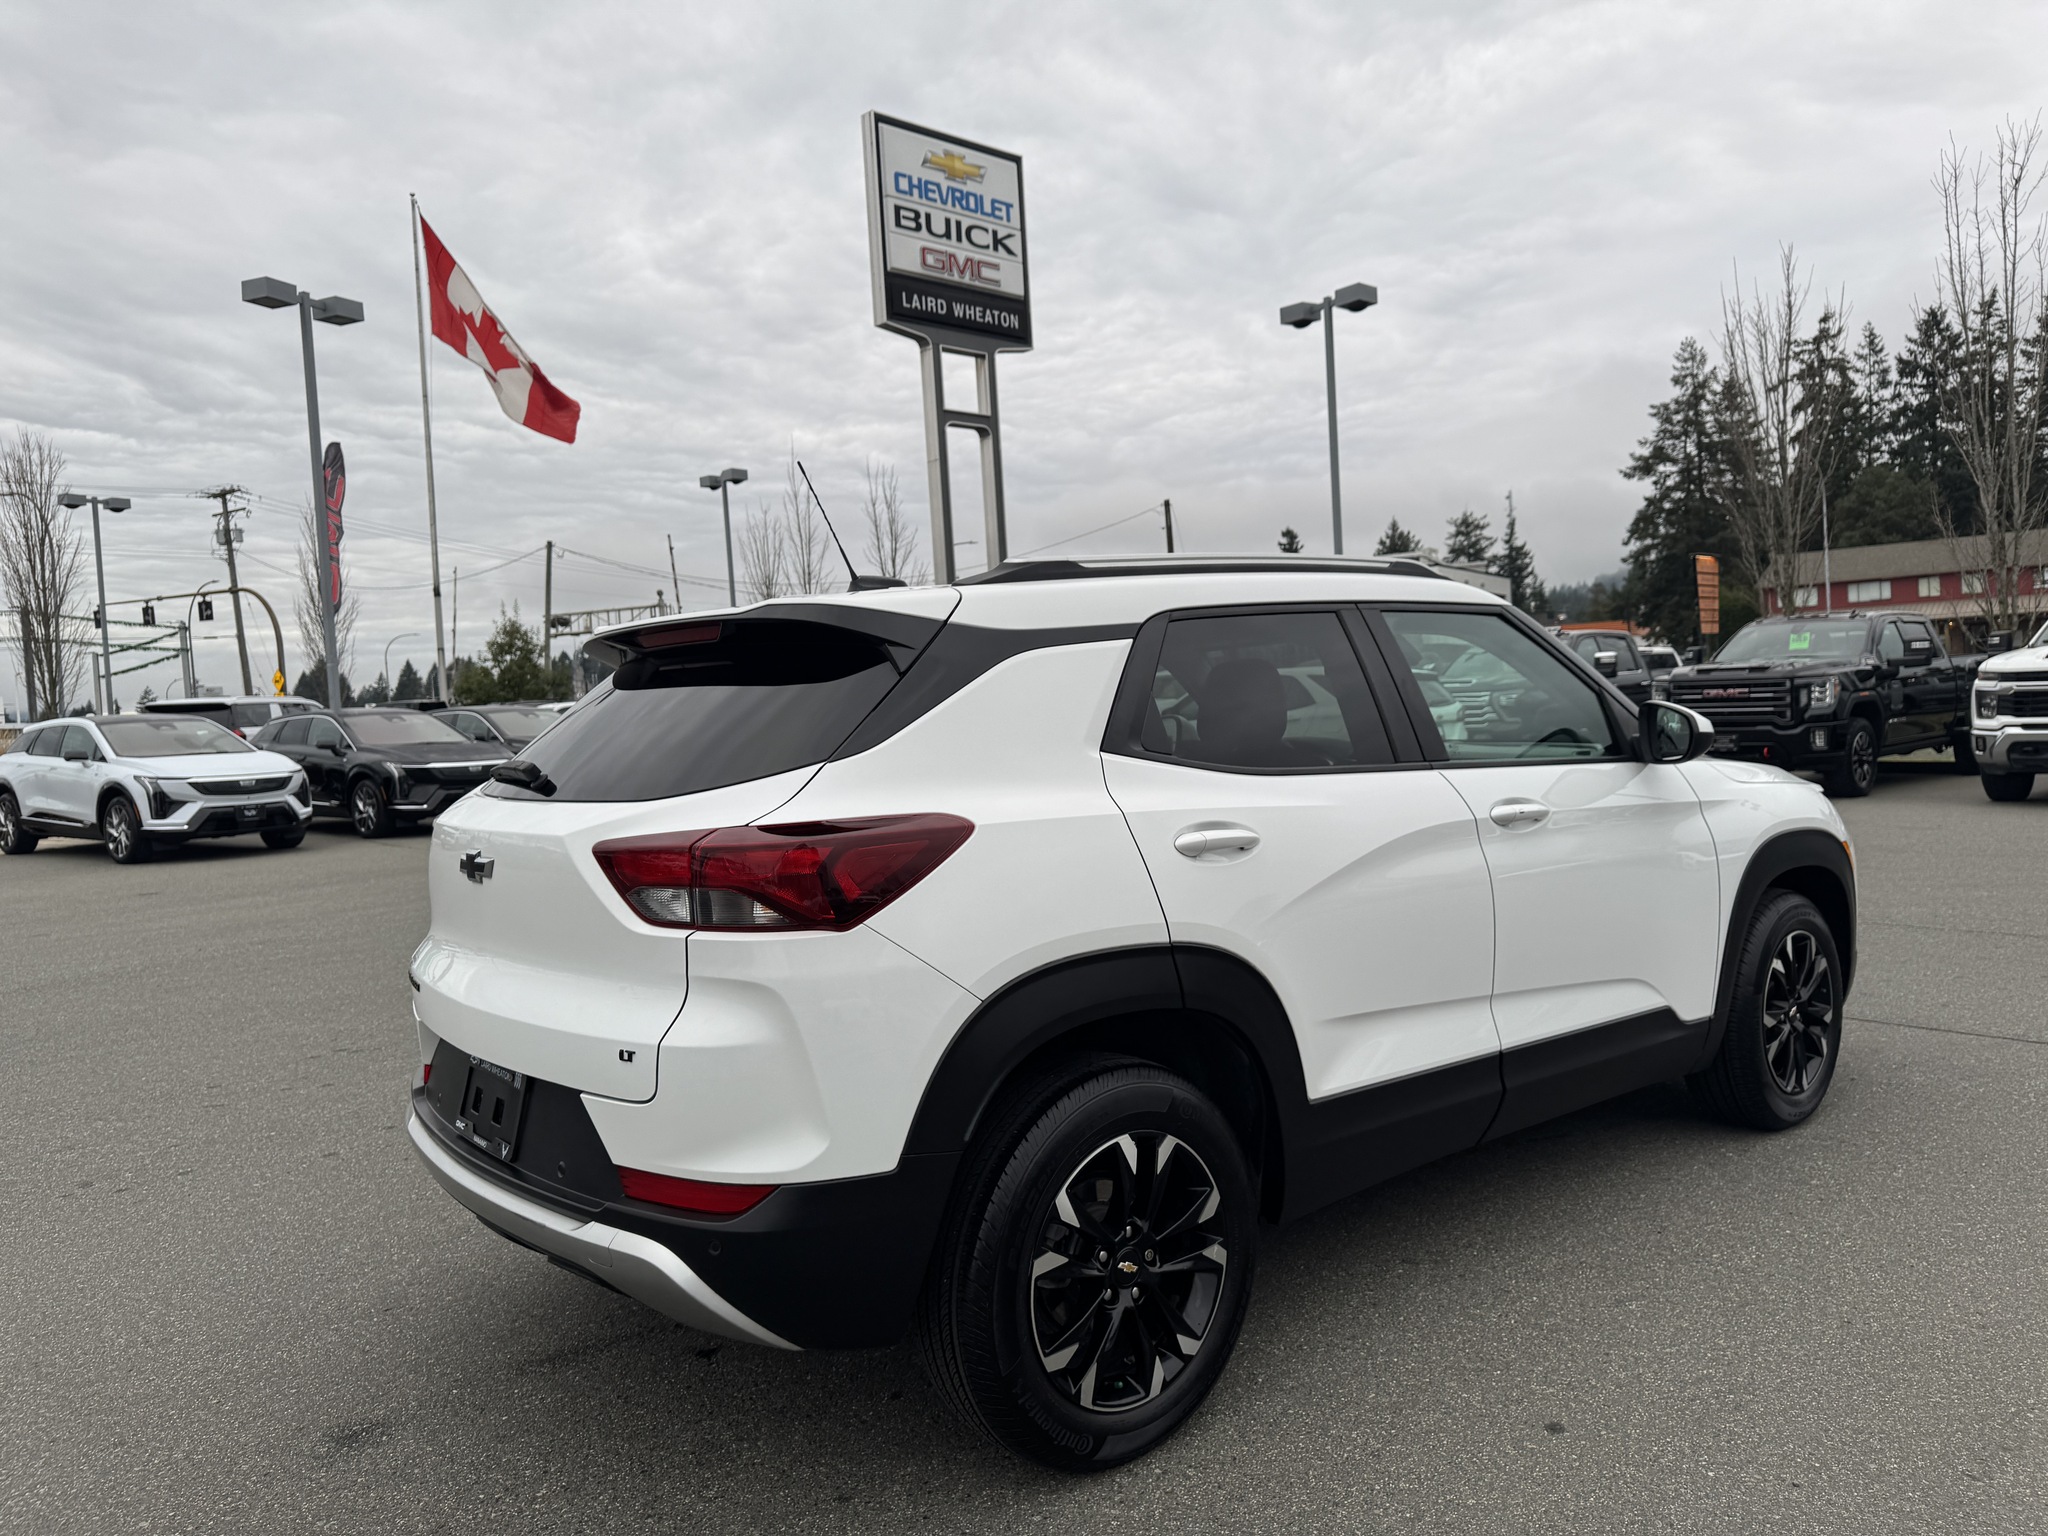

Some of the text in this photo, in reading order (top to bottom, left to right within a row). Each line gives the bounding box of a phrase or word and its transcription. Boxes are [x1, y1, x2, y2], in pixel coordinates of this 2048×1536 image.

[894, 171, 1013, 223] CHEVROLET
[894, 204, 1018, 257] BUICK
[920, 246, 1001, 287] GMC
[902, 291, 1019, 329] LAIRD WHEATON
[1702, 688, 1749, 698] GMC
[619, 1049, 636, 1063] LT
